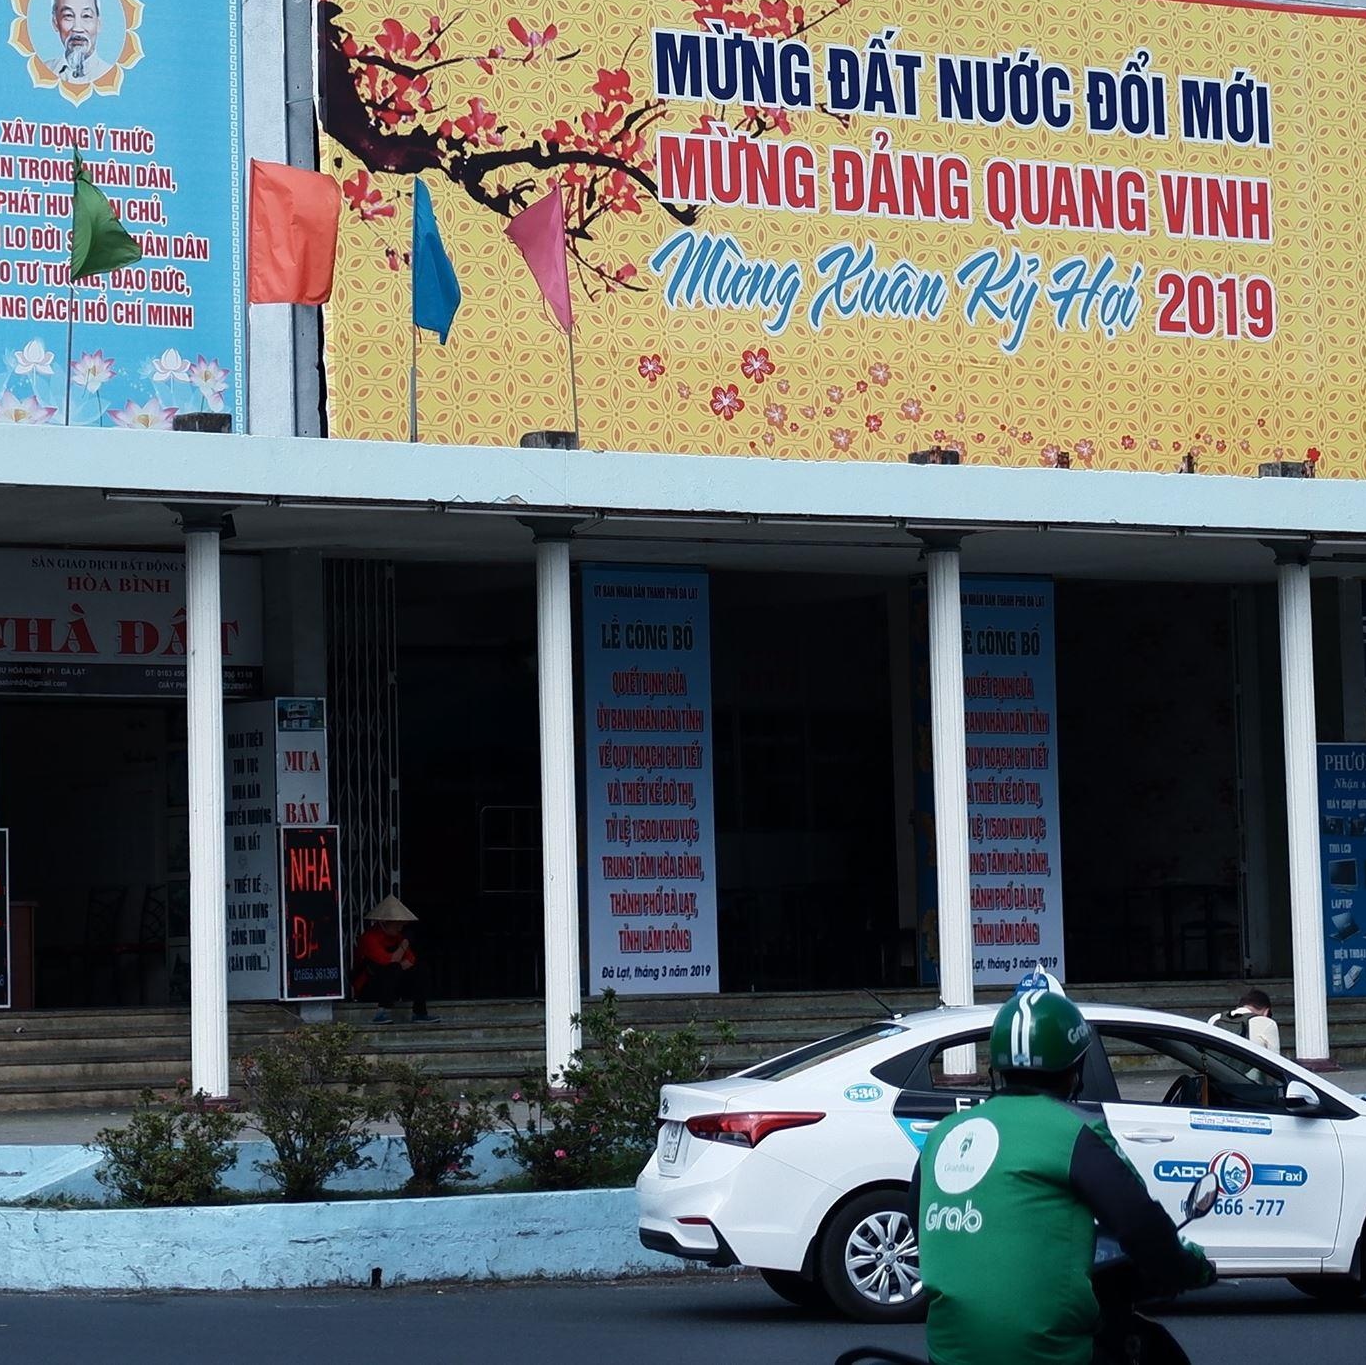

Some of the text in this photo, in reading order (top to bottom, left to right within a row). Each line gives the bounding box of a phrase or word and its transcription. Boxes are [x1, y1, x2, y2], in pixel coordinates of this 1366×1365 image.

[653, 24, 1272, 147] MỪNG ĐẤT NƯỚC ĐỔI MỚI
[1, 118, 154, 154] XÂY DỰNG Ý THỨC
[19, 158, 74, 185] TRỌNG
[136, 163, 176, 192] DÂN,
[656, 121, 1272, 241] MỪNG ĐẢNG QUANG VINH
[127, 195, 167, 224] CHỦ,
[5, 226, 26, 249] LO
[31, 225, 61, 251] ĐỜI
[173, 232, 208, 260] DÂN
[16, 260, 39, 284] TƯ
[111, 267, 145, 295] ĐẠO
[151, 266, 191, 295] ĐỨC,
[650, 232, 1274, 355] Mừng Xuân Kỷ Hợi 2019
[33, 293, 79, 321] CÁCH
[85, 296, 107, 323] HỒ
[113, 299, 142, 325] CHÍ
[148, 304, 193, 328] MINH
[57, 558, 86, 570] GIAO
[66, 573, 171, 593] HÒA BÌNH
[602, 614, 693, 651] LỄ CÔNG BỐ
[284, 751, 320, 772] MUA
[1334, 777, 1359, 791] Nhận
[285, 794, 320, 824] BÁN
[290, 835, 333, 892] NHÀ
[602, 851, 705, 881] TRUNG TÂM HÒA BÌNH,
[610, 889, 642, 917] THÀNH
[642, 922, 692, 953] LÂM ĐỒNG
[602, 965, 711, 982] Đà Lạt, tháng 3 năm 2019
[848, 1087, 879, 1100] 536
[1278, 1170, 1303, 1182] Taxi
[925, 1199, 983, 1233] Grab
